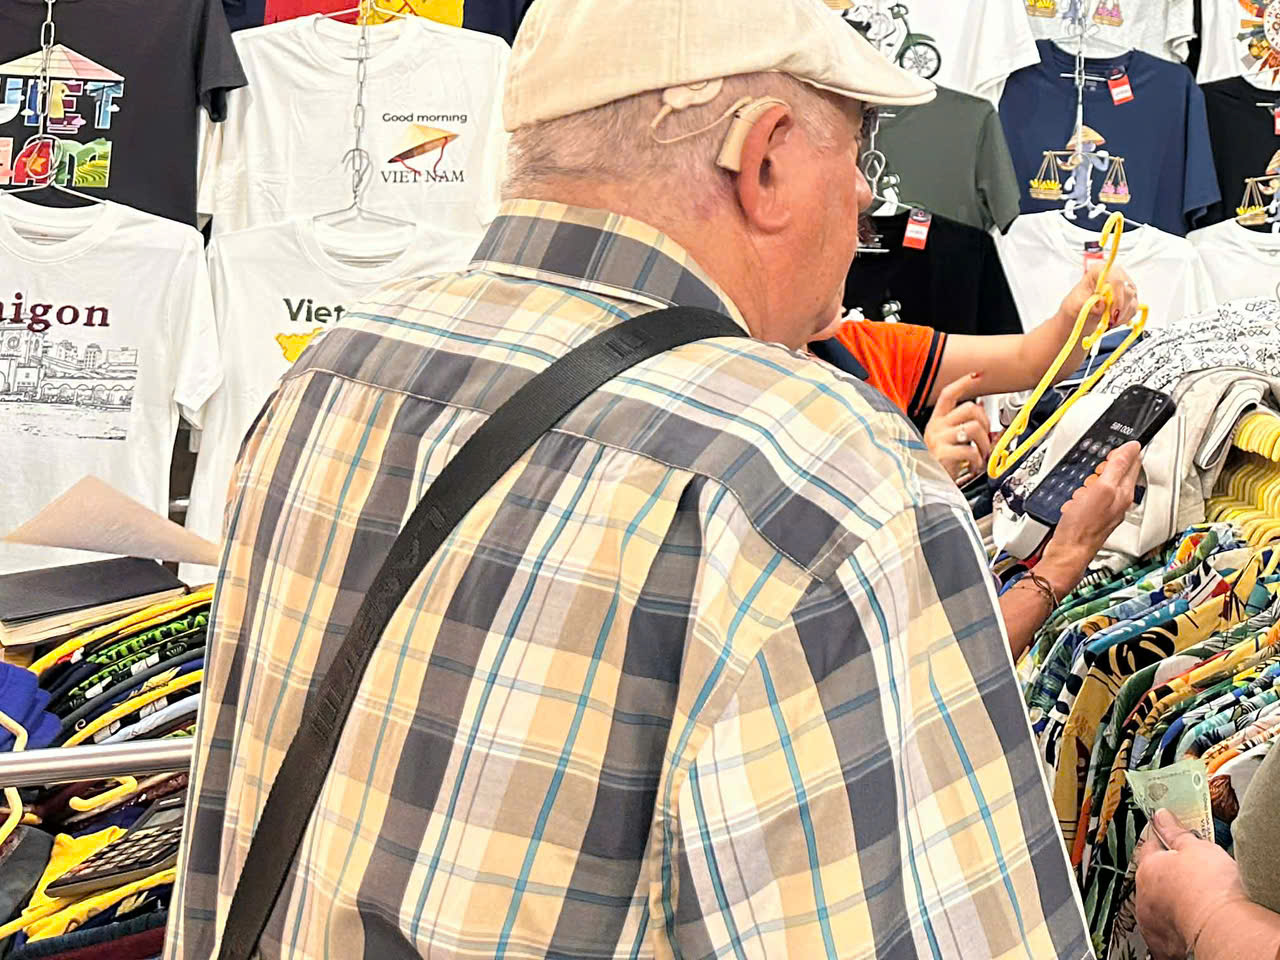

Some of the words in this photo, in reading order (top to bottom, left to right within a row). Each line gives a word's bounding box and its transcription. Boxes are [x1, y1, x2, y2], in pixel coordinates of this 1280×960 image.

[381, 112, 415, 123] Good
[416, 112, 468, 124] morning
[380, 170, 421, 184] VIET
[425, 170, 465, 184] NAM
[0, 292, 110, 333] igon
[282, 297, 347, 324] Viet
